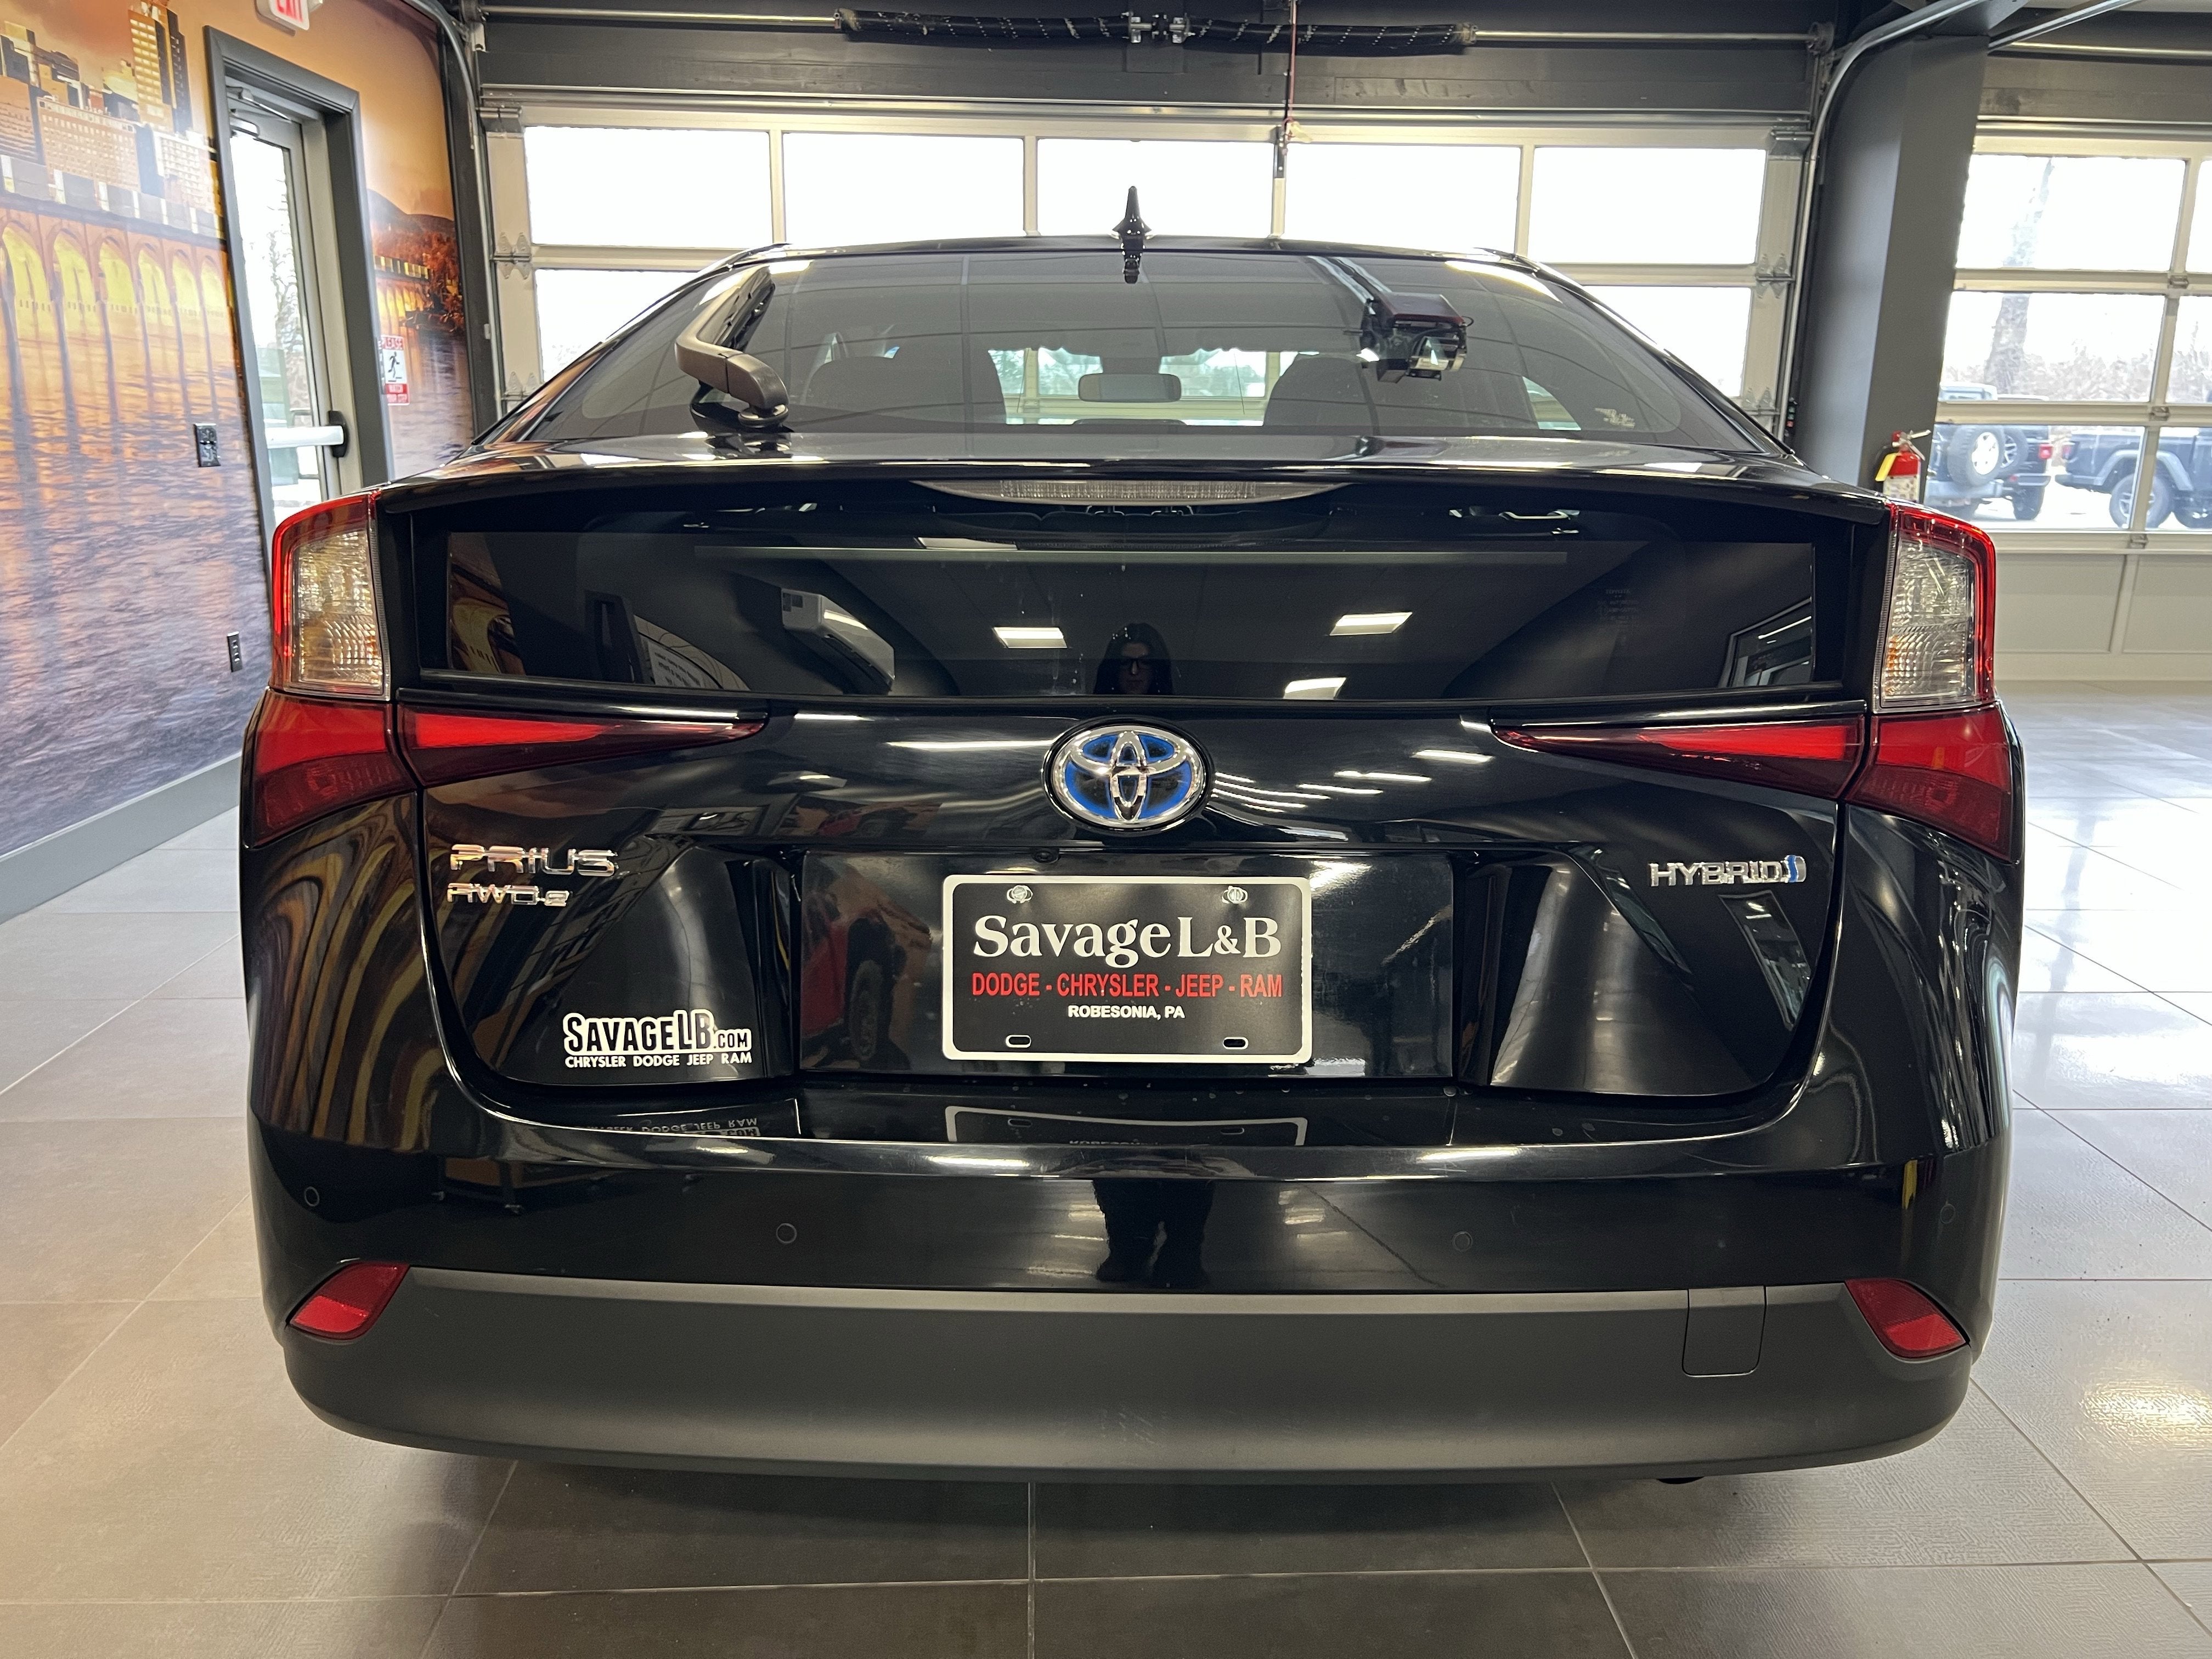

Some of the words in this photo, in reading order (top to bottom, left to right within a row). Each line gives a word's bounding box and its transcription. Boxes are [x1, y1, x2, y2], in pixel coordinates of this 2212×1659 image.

[450, 844, 618, 877] PRIUS
[1648, 861, 1784, 887] HYBRID
[972, 973, 1040, 996] DODGE
[1057, 973, 1159, 997] CHRYSLER
[1175, 974, 1224, 997] JEEP
[1240, 974, 1282, 997] RAM
[1068, 1005, 1161, 1020] ROBESONIA,
[1164, 1006, 1185, 1019] PA
[565, 1056, 627, 1068] CHRYSLER
[633, 1054, 680, 1066] DODGE
[686, 1053, 714, 1066] JEEP
[721, 1052, 752, 1064] RAM
